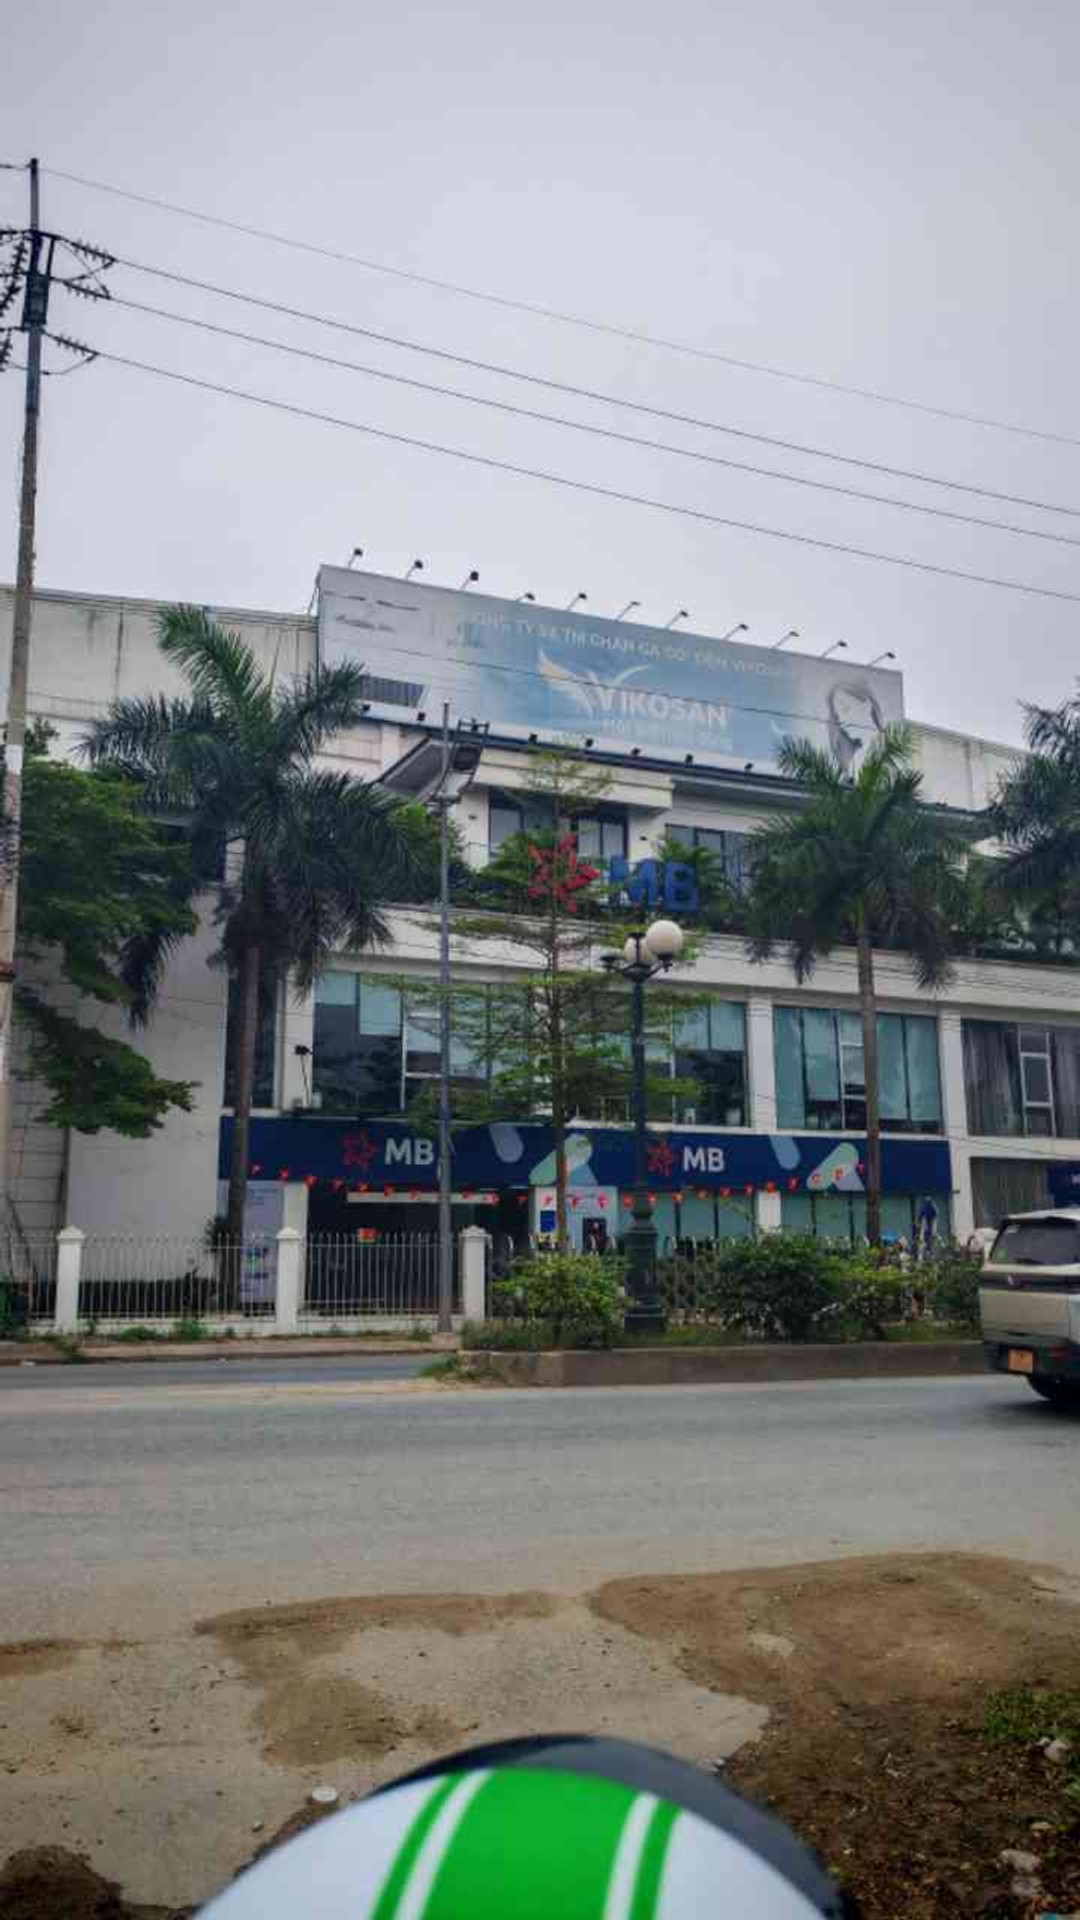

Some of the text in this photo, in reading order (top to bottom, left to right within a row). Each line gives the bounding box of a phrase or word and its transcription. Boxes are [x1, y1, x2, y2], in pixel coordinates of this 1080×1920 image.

[598, 687, 728, 727] VIKOSAN
[608, 855, 697, 912] MB
[384, 1138, 434, 1165] MB
[683, 1146, 725, 1172] MB
